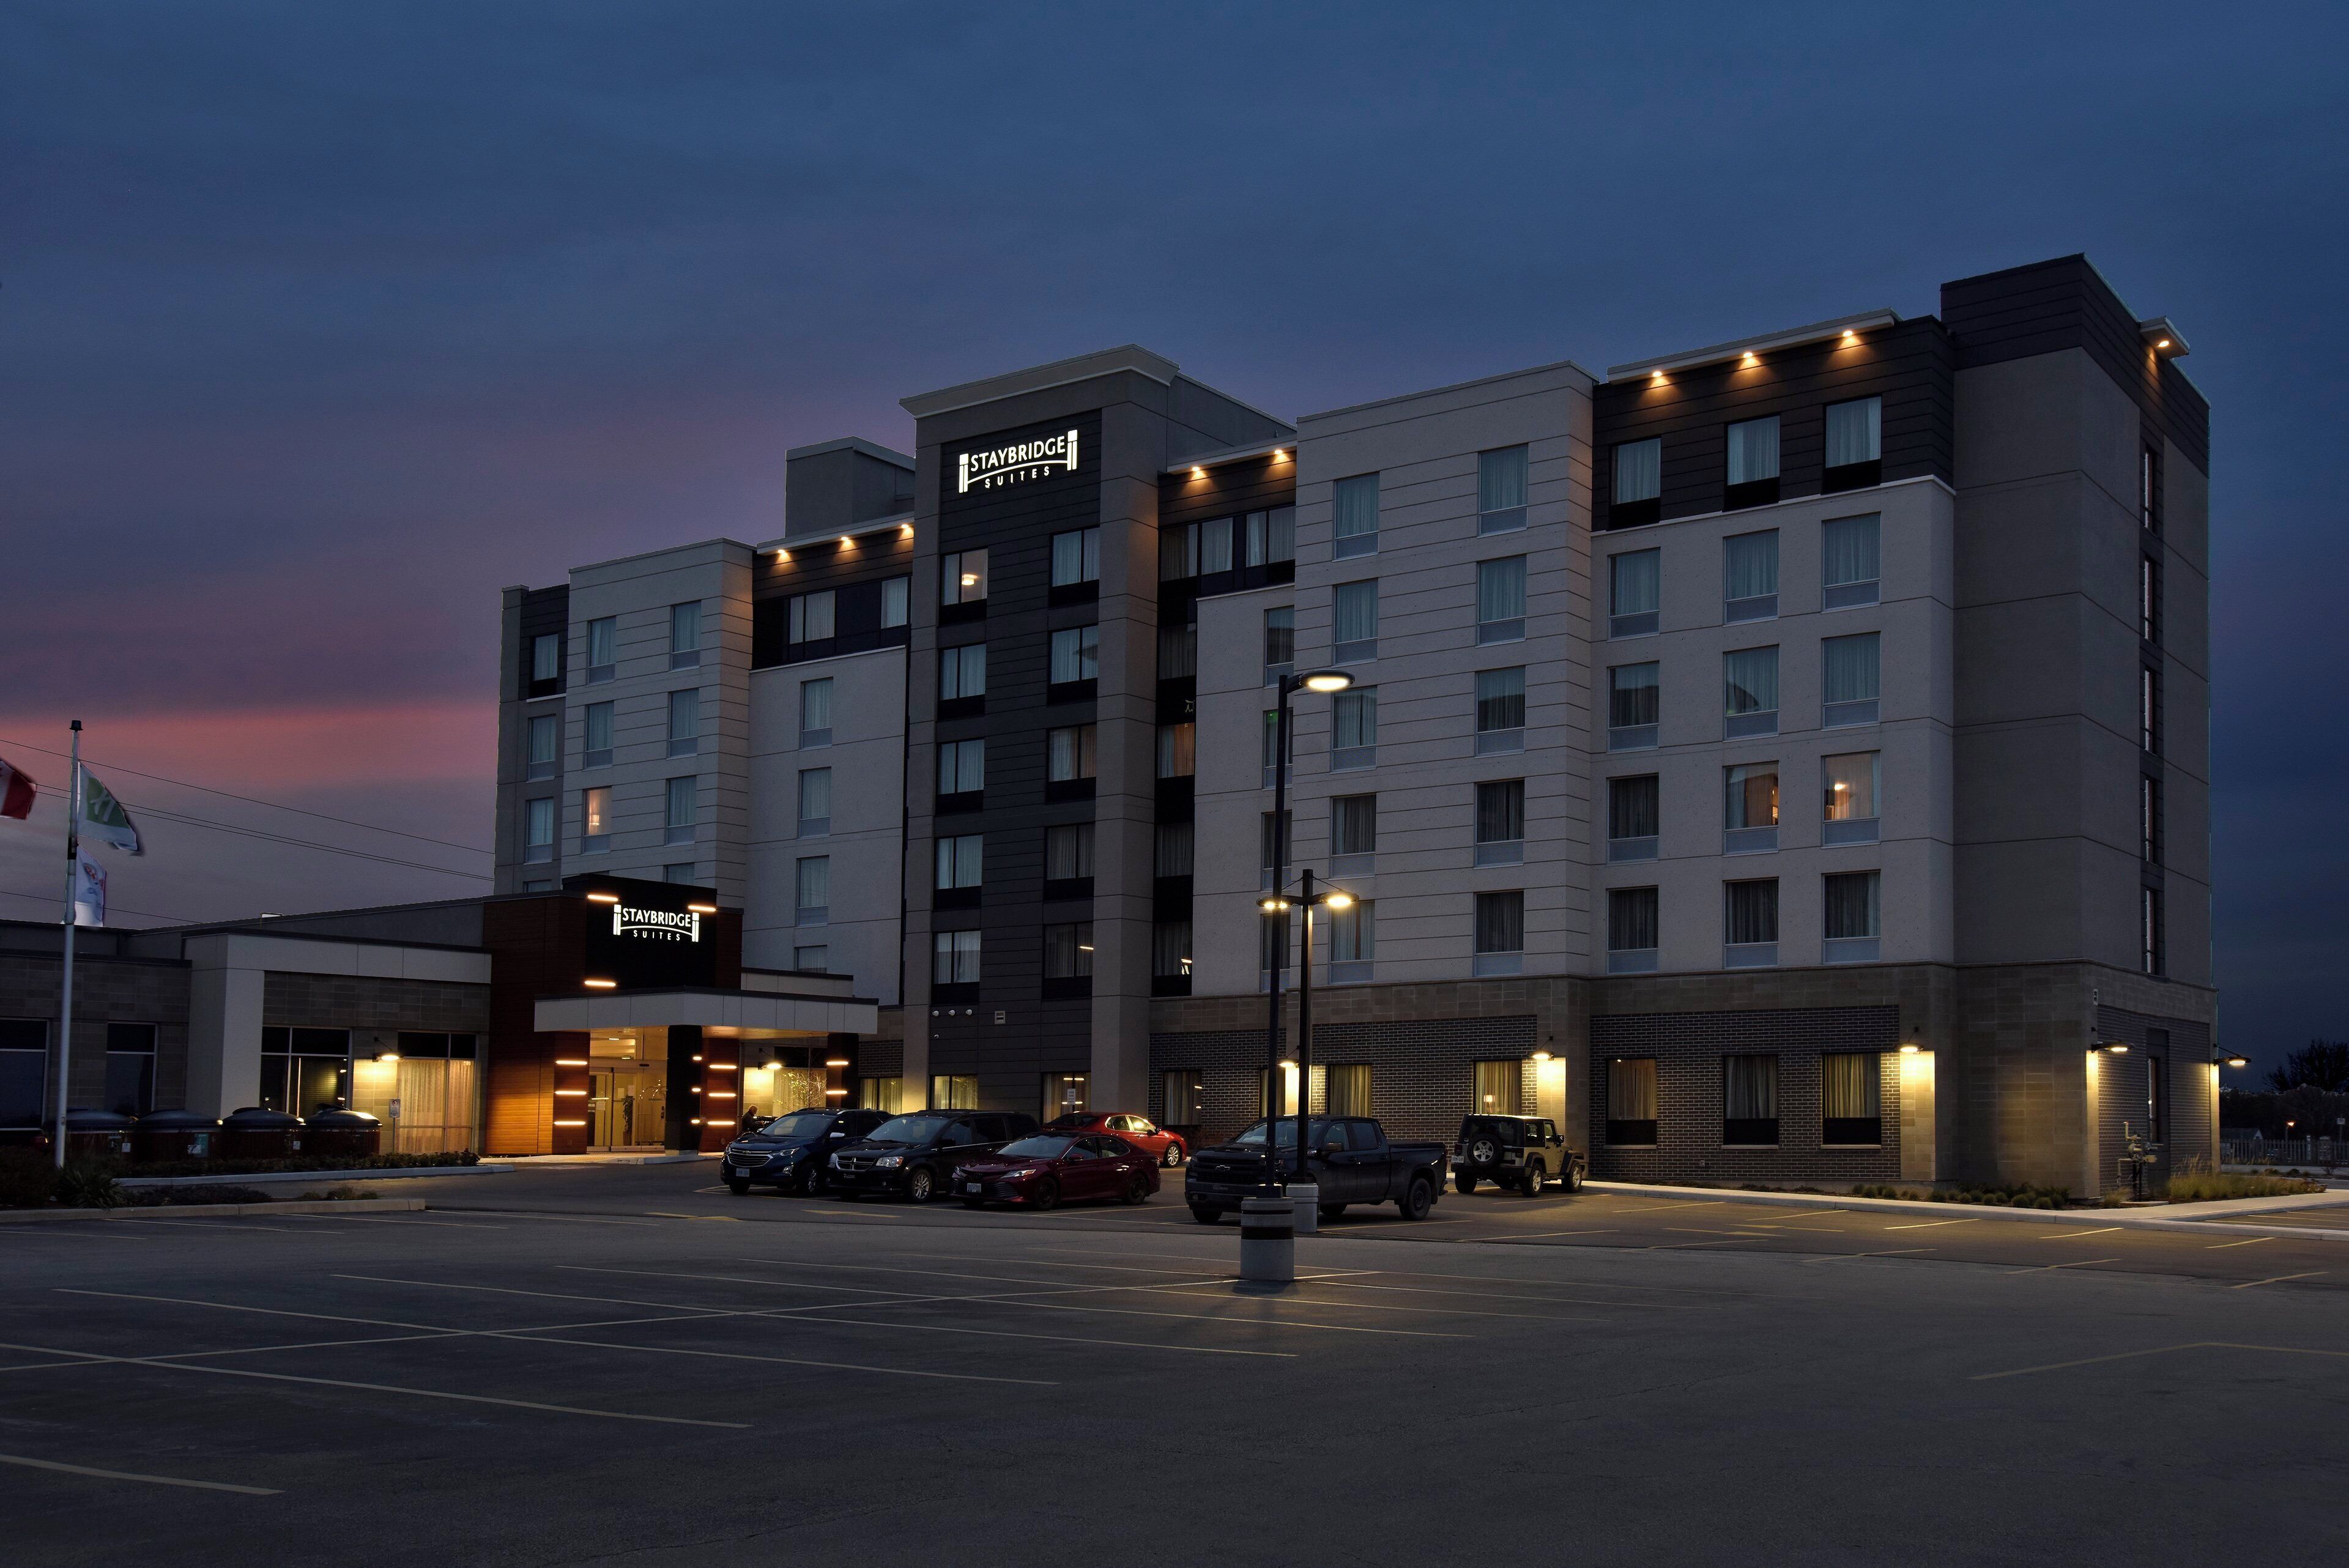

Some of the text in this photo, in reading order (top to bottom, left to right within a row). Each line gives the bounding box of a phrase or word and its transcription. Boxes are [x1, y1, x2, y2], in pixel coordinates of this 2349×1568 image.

[970, 435, 1066, 472] STAYBRIDGE
[984, 466, 1050, 489] SUITES
[622, 907, 691, 927] STAYBRIDGE
[633, 929, 680, 941] SUITES
